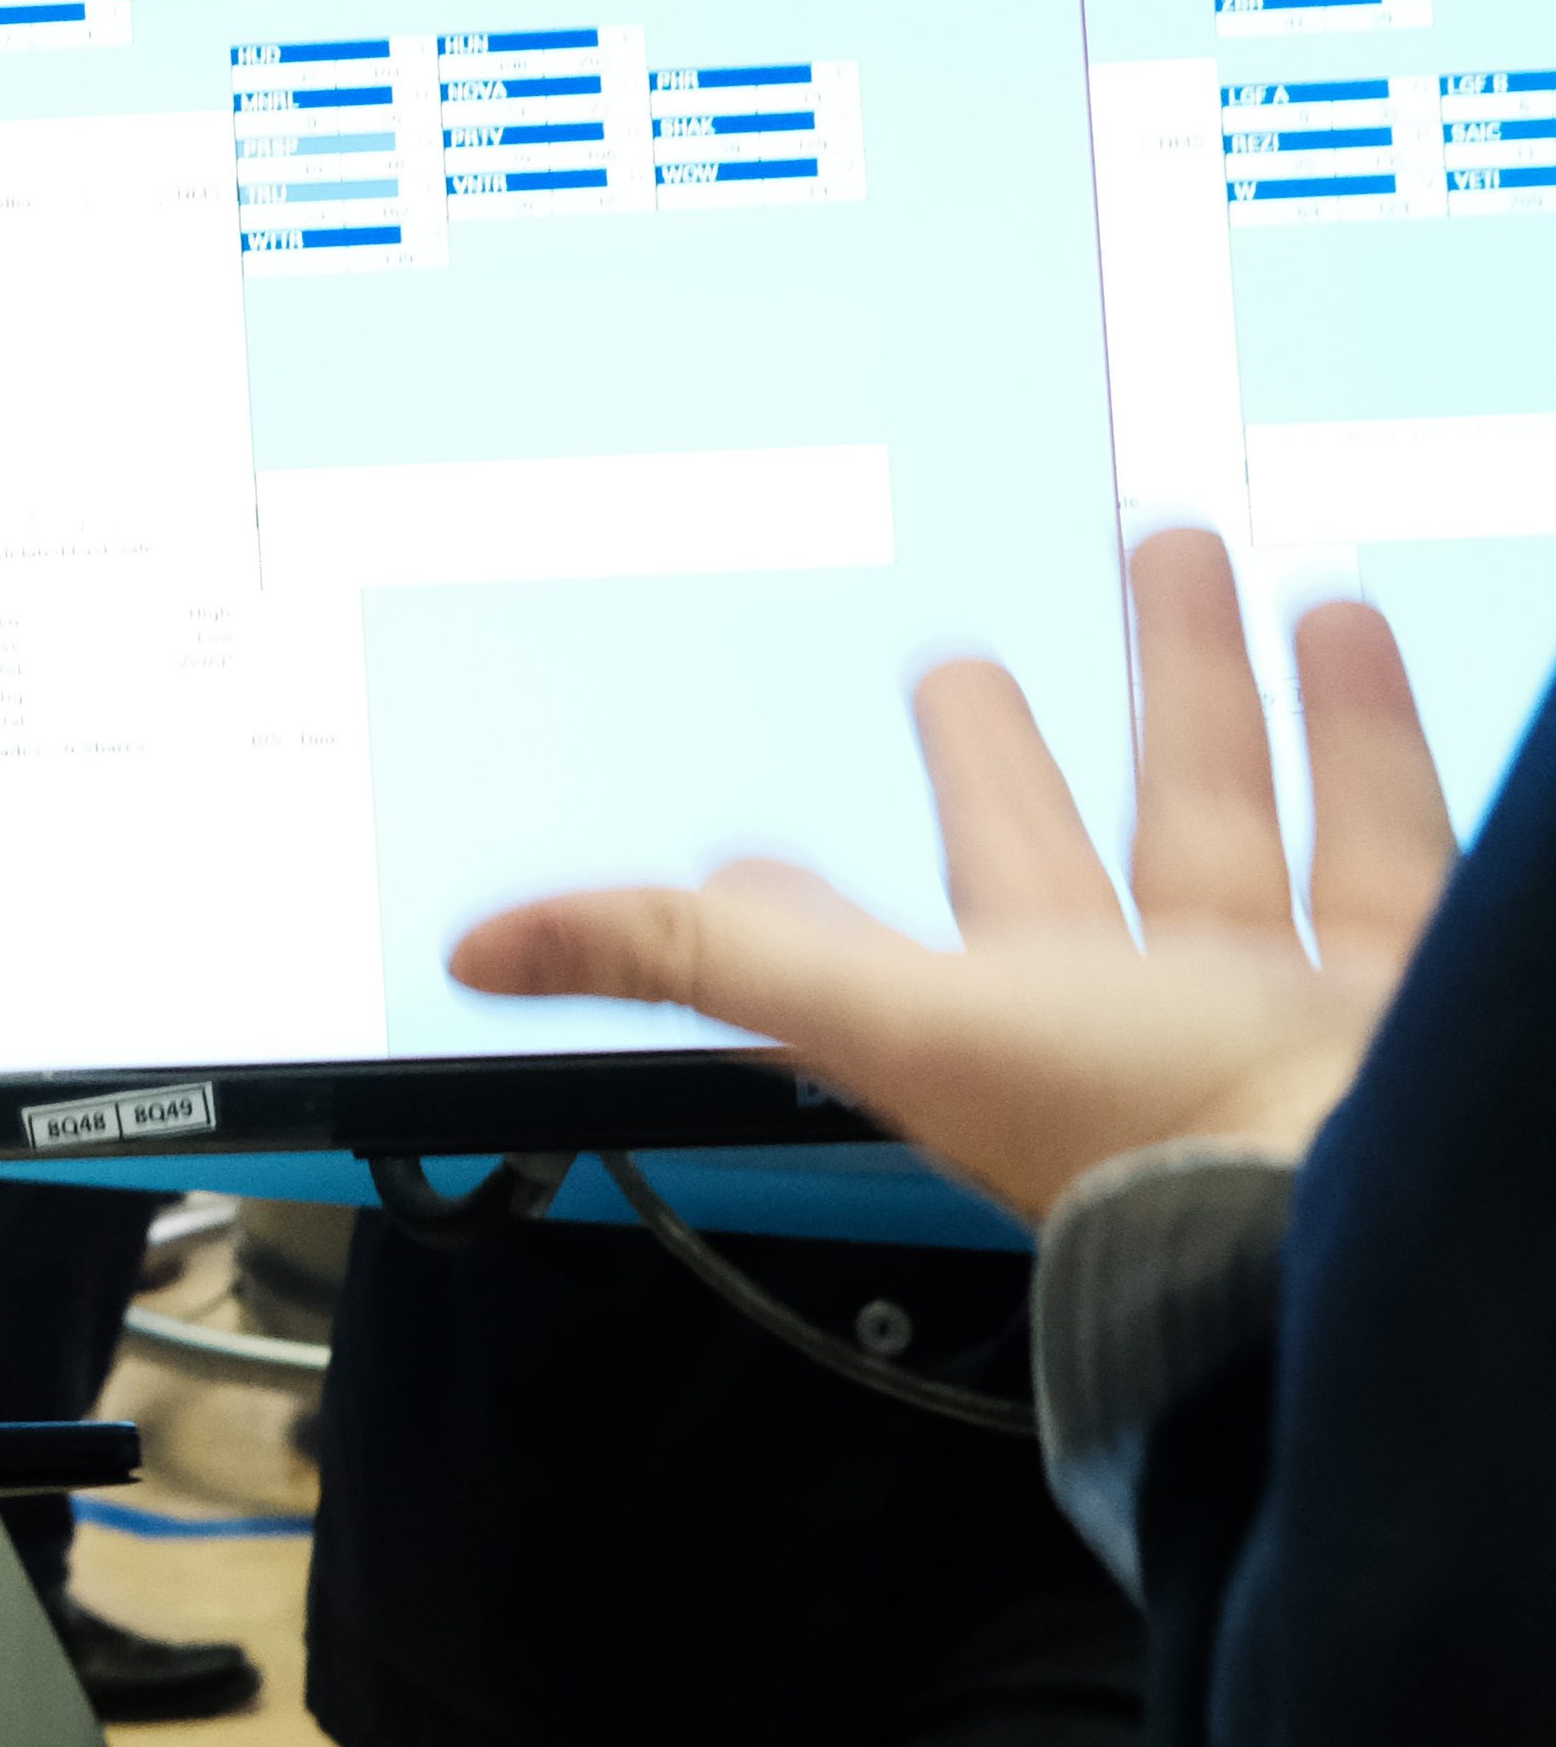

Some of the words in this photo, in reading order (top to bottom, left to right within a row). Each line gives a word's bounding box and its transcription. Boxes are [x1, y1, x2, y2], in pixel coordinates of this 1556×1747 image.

[662, 163, 719, 185] WOW
[1234, 181, 1257, 202] W
[48, 1113, 107, 1139] 8Q48
[135, 1099, 193, 1124] 8Q49
